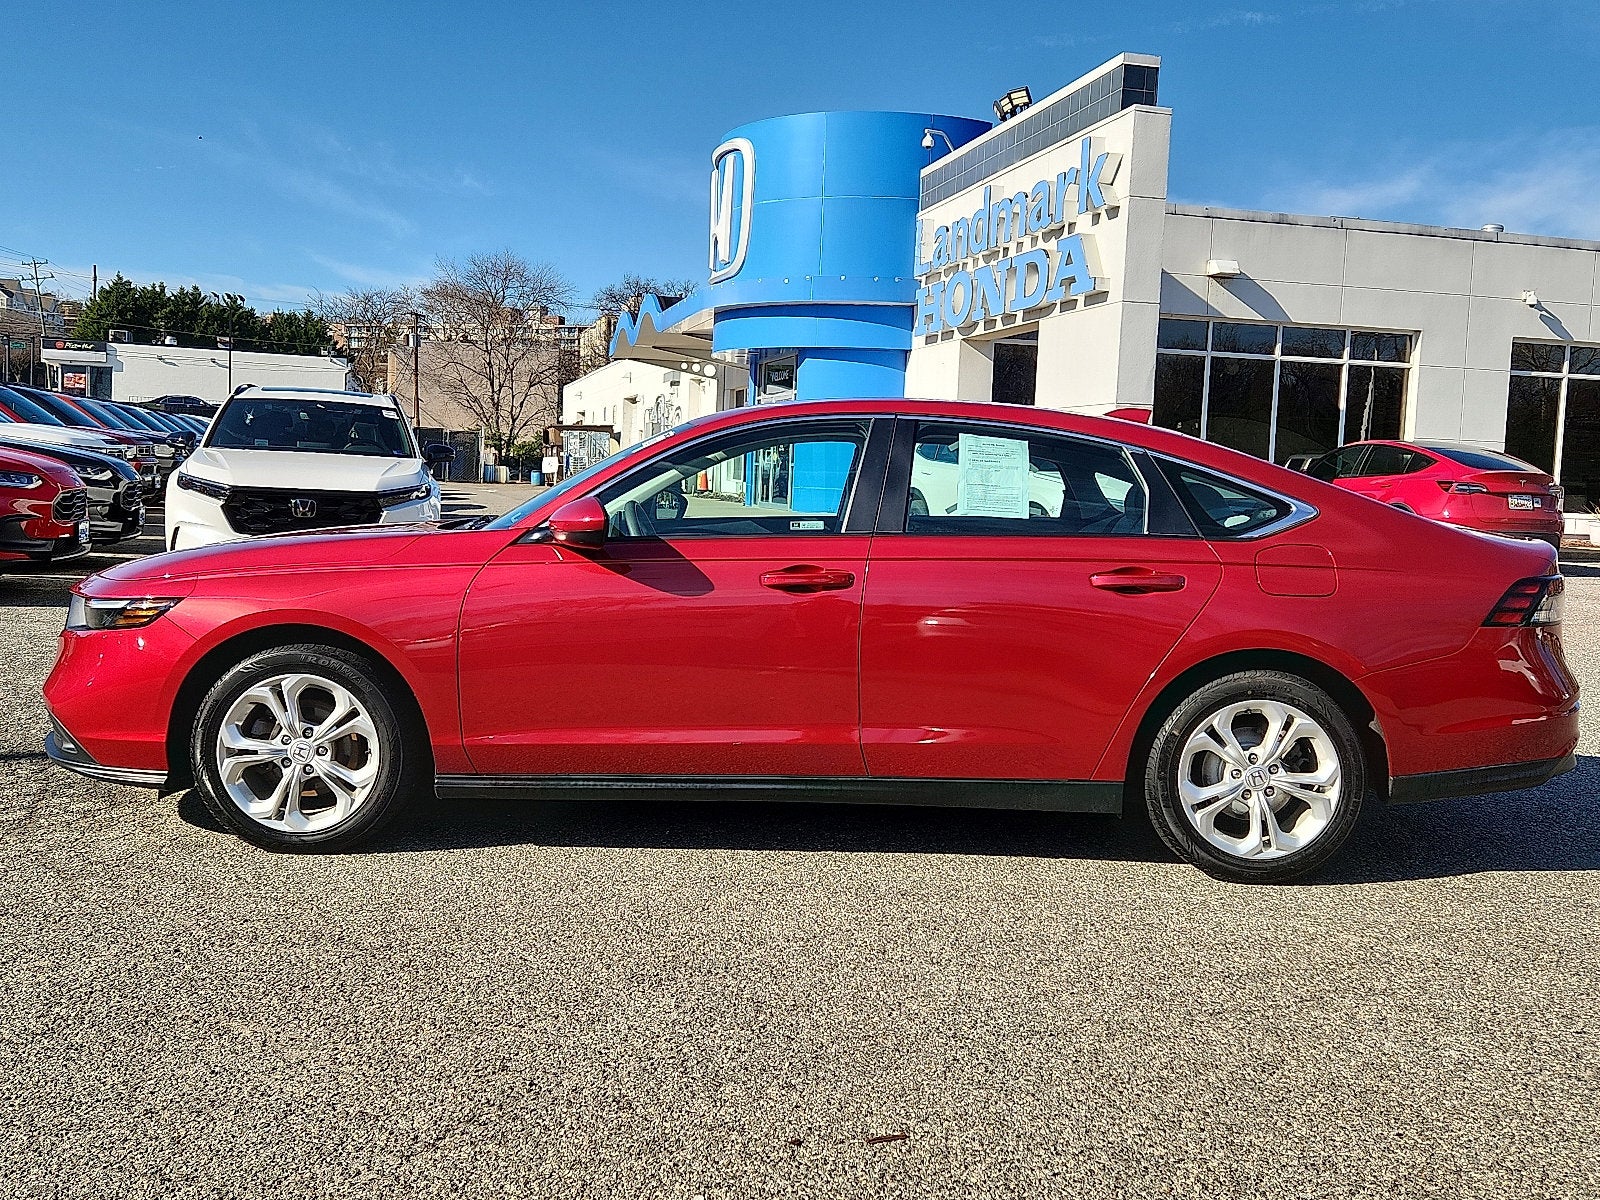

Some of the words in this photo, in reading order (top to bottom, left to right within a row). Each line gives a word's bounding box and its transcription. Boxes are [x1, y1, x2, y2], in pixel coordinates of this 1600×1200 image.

[914, 136, 1112, 278] Landmark
[914, 232, 1097, 337] HONDA
[769, 369, 790, 382] WELCOME
[299, 653, 373, 693] IRONMAN
